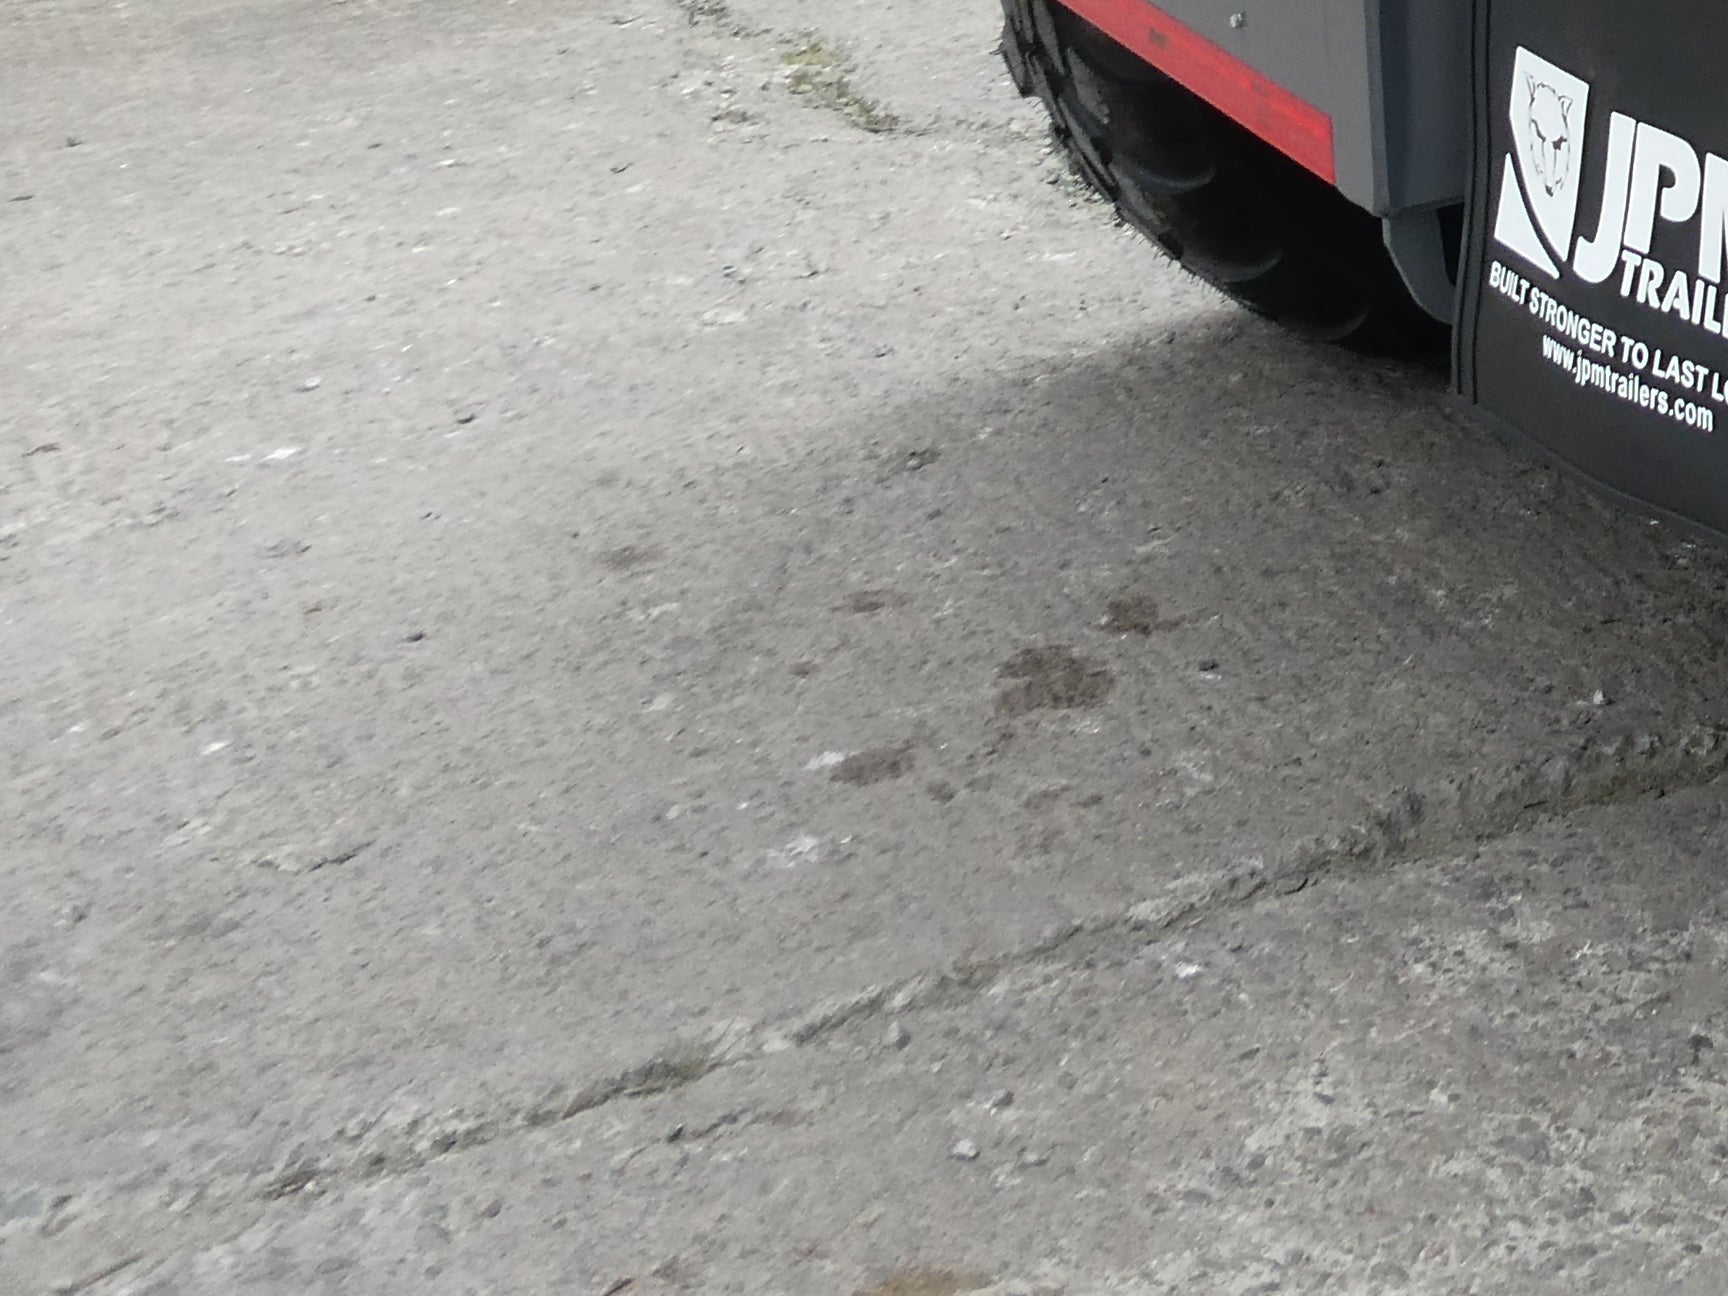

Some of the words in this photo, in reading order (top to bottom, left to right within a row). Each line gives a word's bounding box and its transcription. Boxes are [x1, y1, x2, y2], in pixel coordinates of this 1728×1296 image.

[1489, 260, 1529, 305] BUILT
[1529, 287, 1615, 353] STRONGER
[1620, 335, 1649, 369] TO
[1653, 349, 1709, 392] LAST
[1542, 334, 1713, 432] www.jpmtrailers.com
